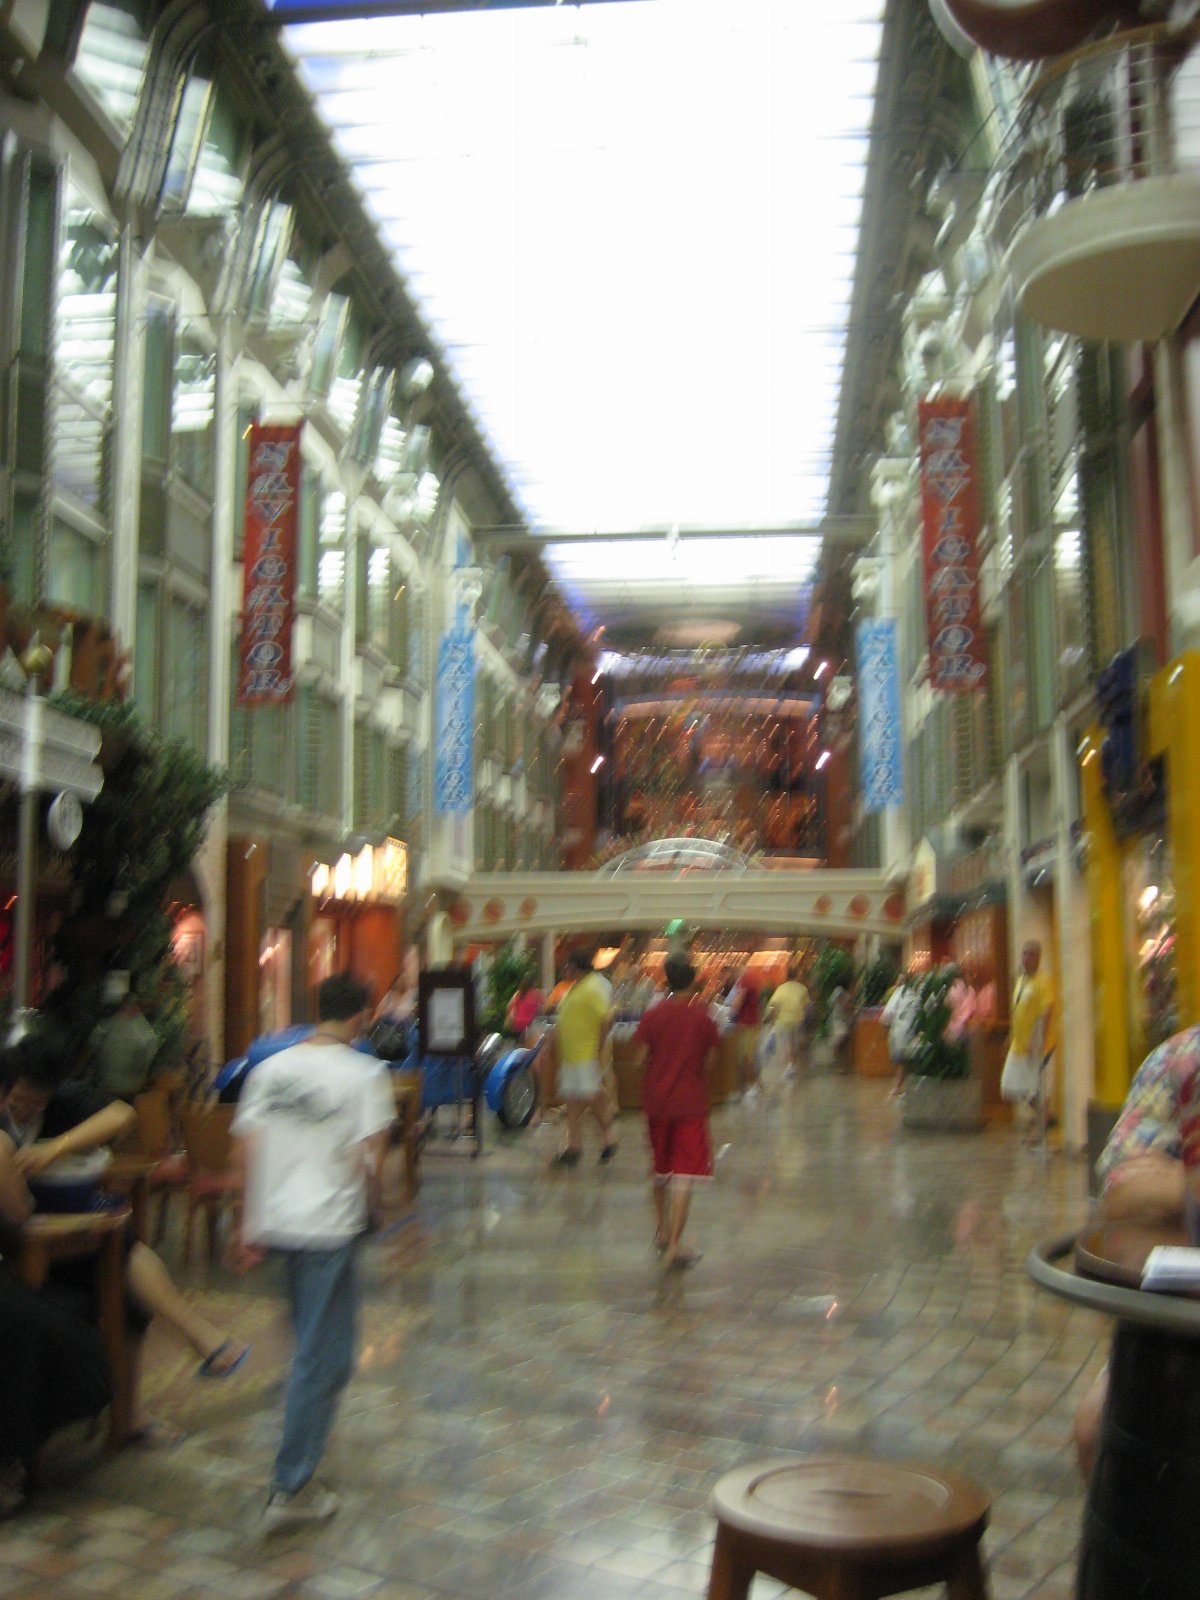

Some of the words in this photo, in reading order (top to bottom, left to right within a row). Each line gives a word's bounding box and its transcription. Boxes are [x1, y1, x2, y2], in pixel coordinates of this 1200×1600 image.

[248, 441, 293, 696] NAVIGATOR
[925, 416, 987, 682] NAVIGATOR
[445, 641, 474, 805] NAVIGATOR
[864, 633, 901, 799] NAVIGATOR
